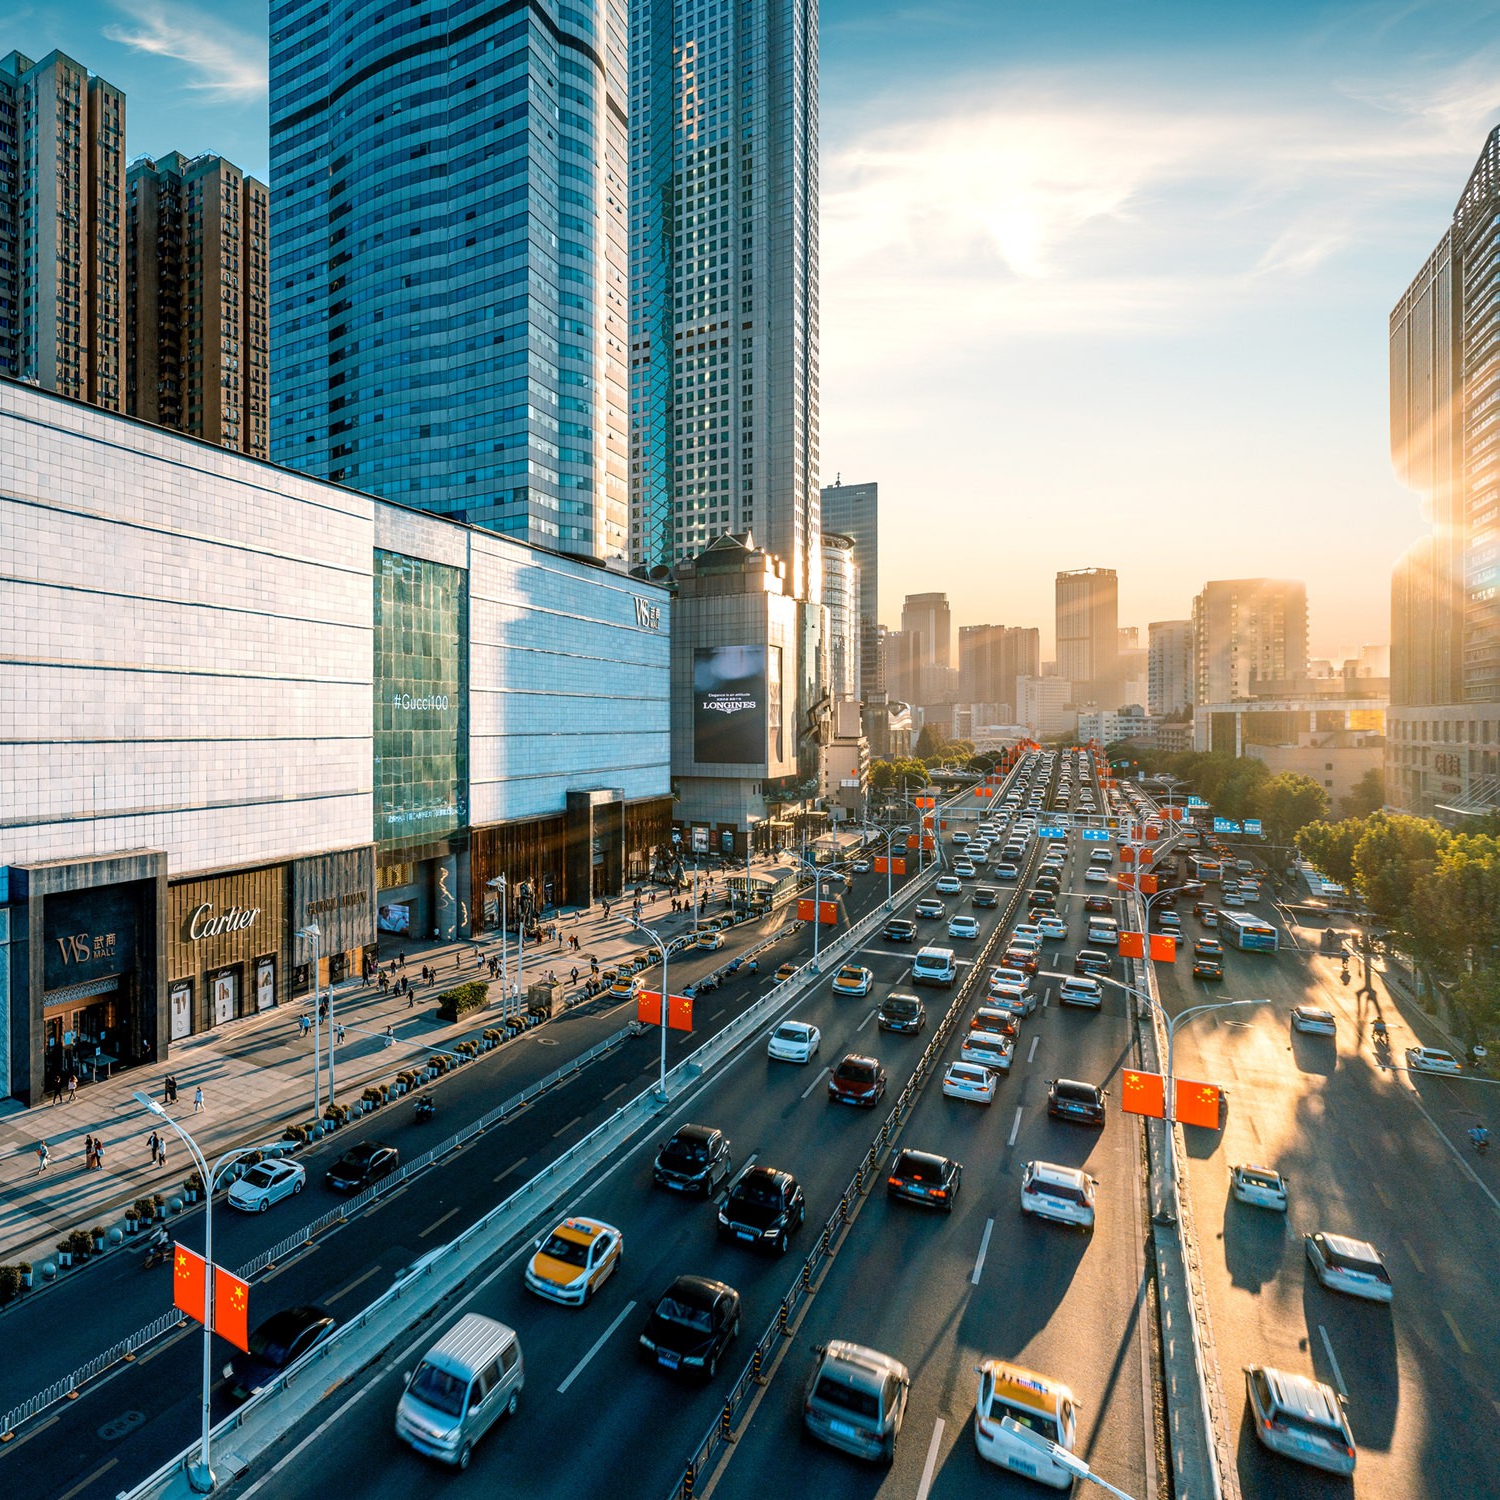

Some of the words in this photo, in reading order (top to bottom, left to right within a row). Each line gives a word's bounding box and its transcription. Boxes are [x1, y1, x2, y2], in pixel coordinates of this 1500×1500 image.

[393, 693, 449, 711] #Gucci100
[703, 701, 756, 709] LONGINES
[190, 902, 260, 941] Cartier
[93, 933, 116, 950] 武商
[93, 948, 116, 959] MALL
